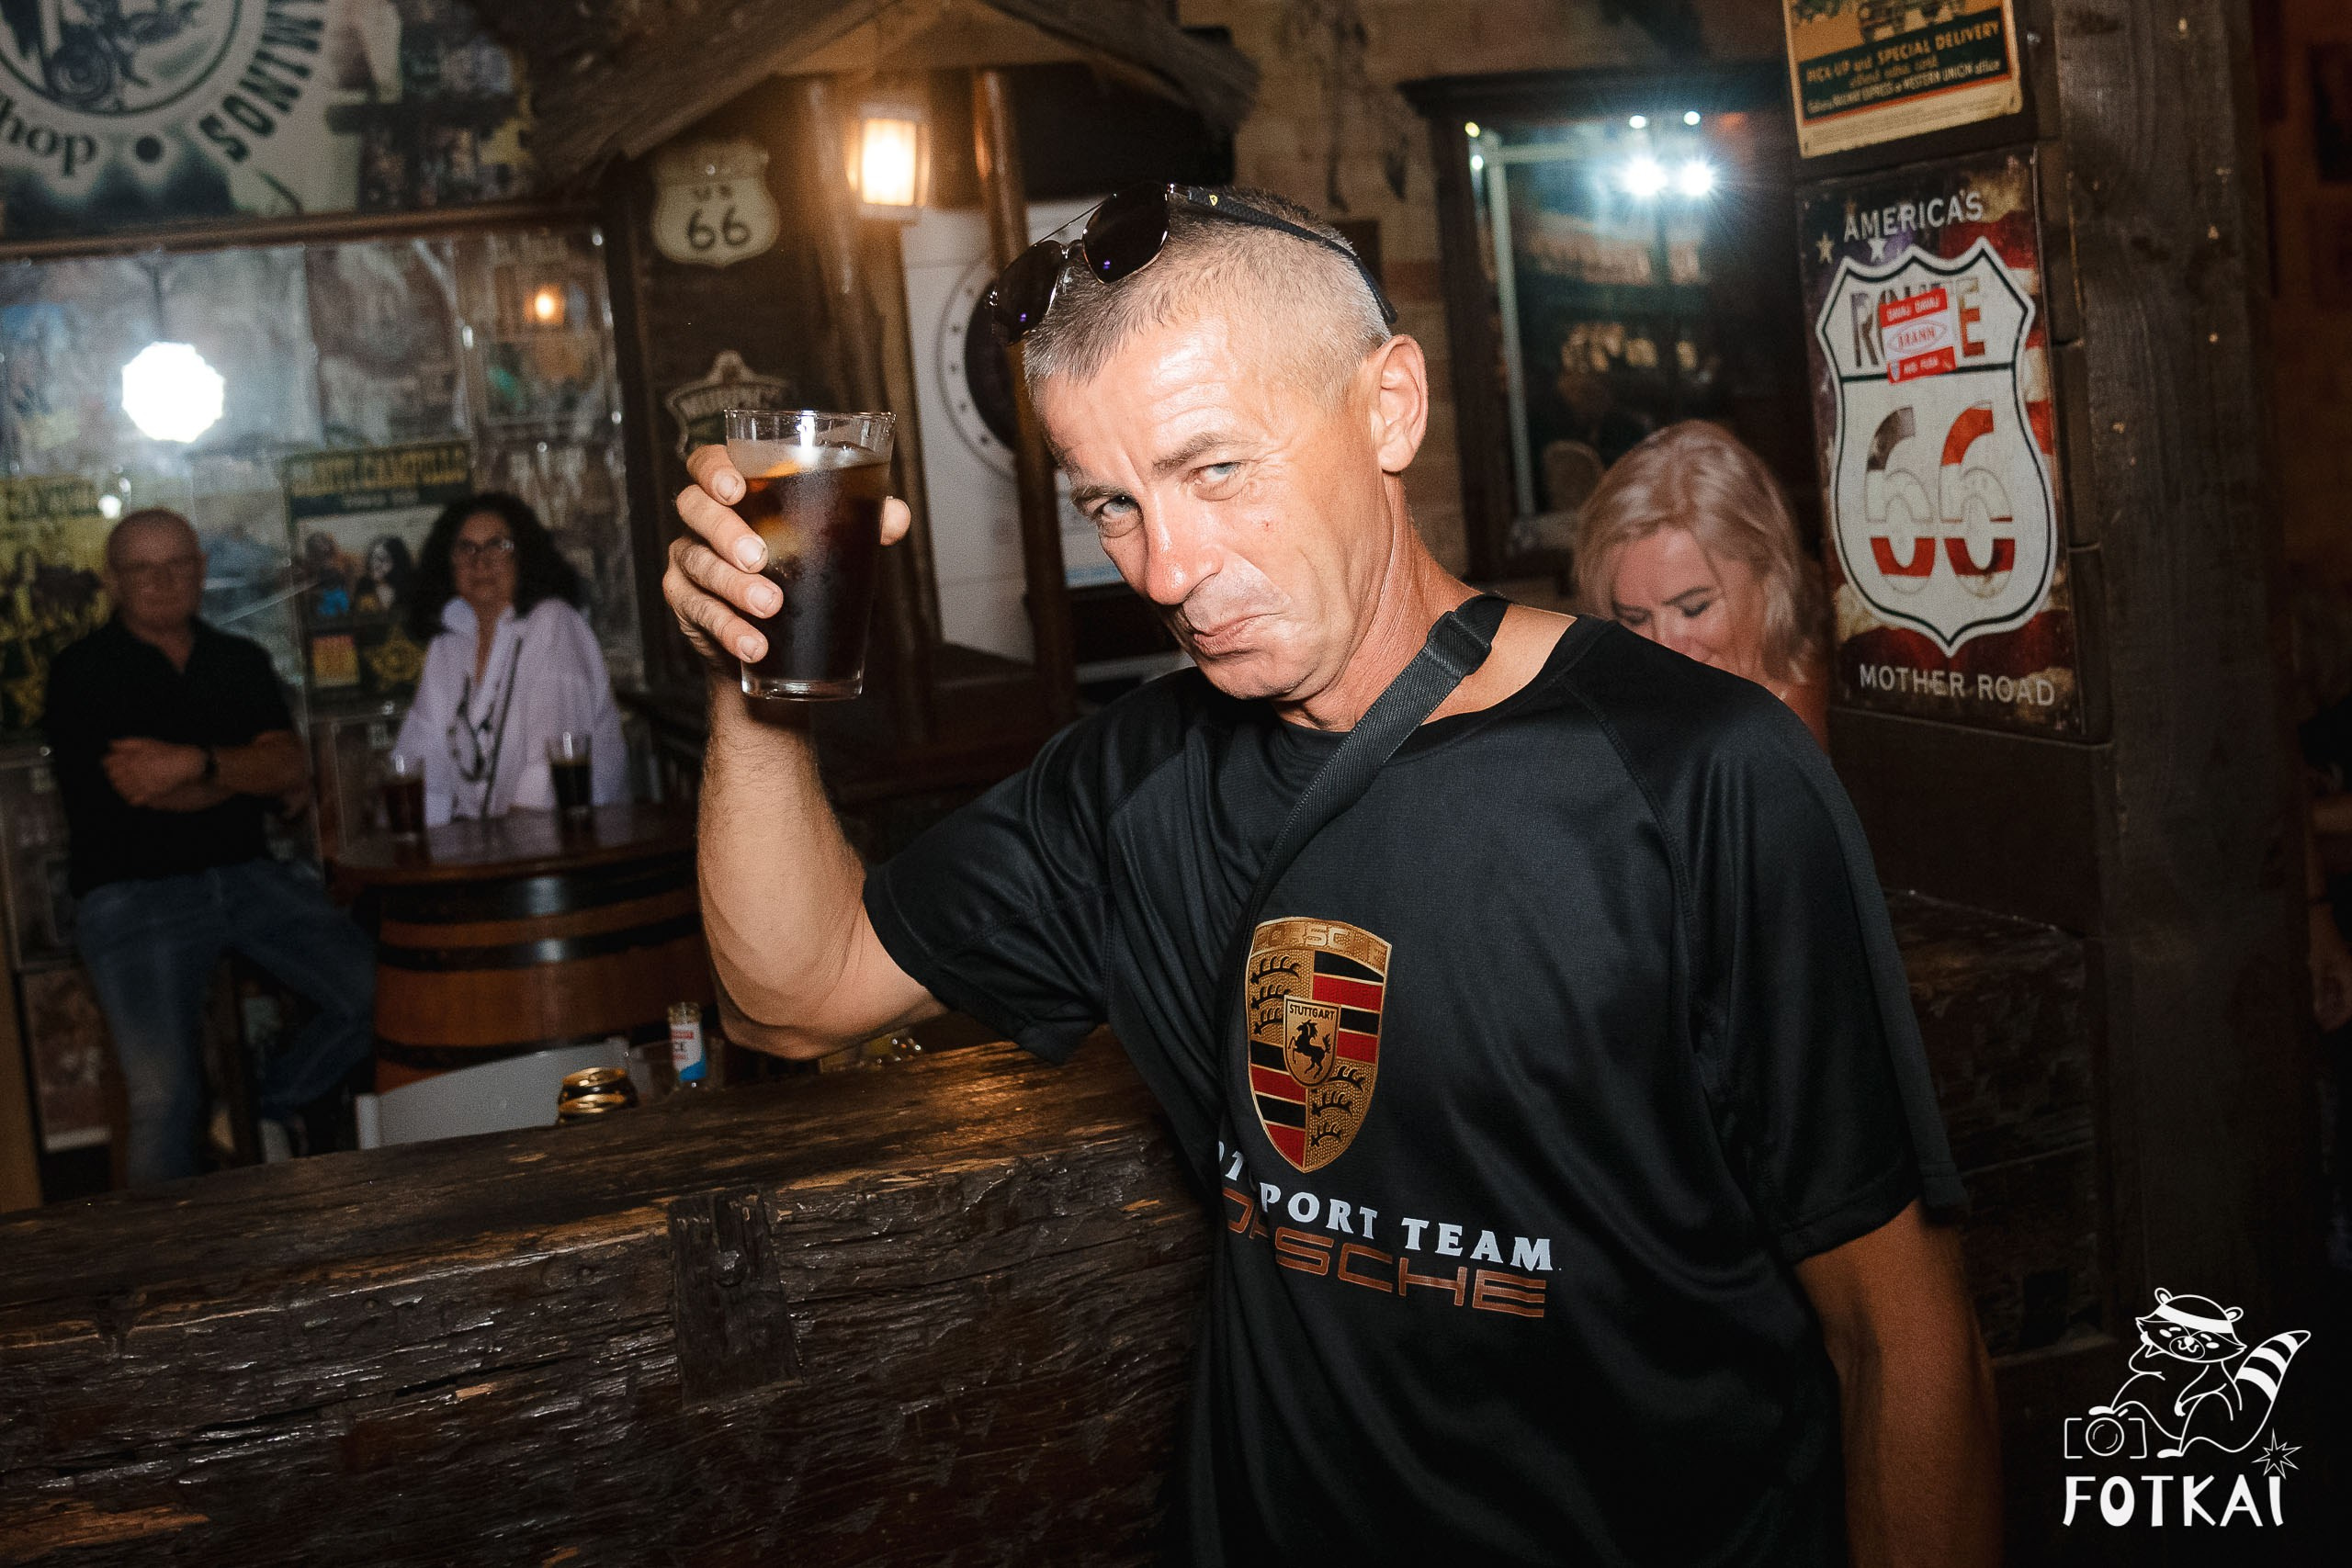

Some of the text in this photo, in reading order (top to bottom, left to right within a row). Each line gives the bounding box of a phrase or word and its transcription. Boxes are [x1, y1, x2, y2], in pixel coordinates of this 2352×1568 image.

[1834, 60, 1851, 75] UP
[1856, 56, 1873, 71] and
[1877, 38, 1931, 65] SPECIAL
[1935, 20, 2000, 51] DELIVERY
[1942, 62, 1973, 83] UNION
[199, 0, 325, 163] MINOS
[687, 206, 752, 250] 66
[1844, 189, 1984, 243] AMERICA'S
[1864, 400, 2015, 597] 66
[1860, 663, 2055, 706] MOTHER ROAD
[1289, 1003, 1335, 1021] STUTTGART
[1401, 1217, 1555, 1272] TEAM
